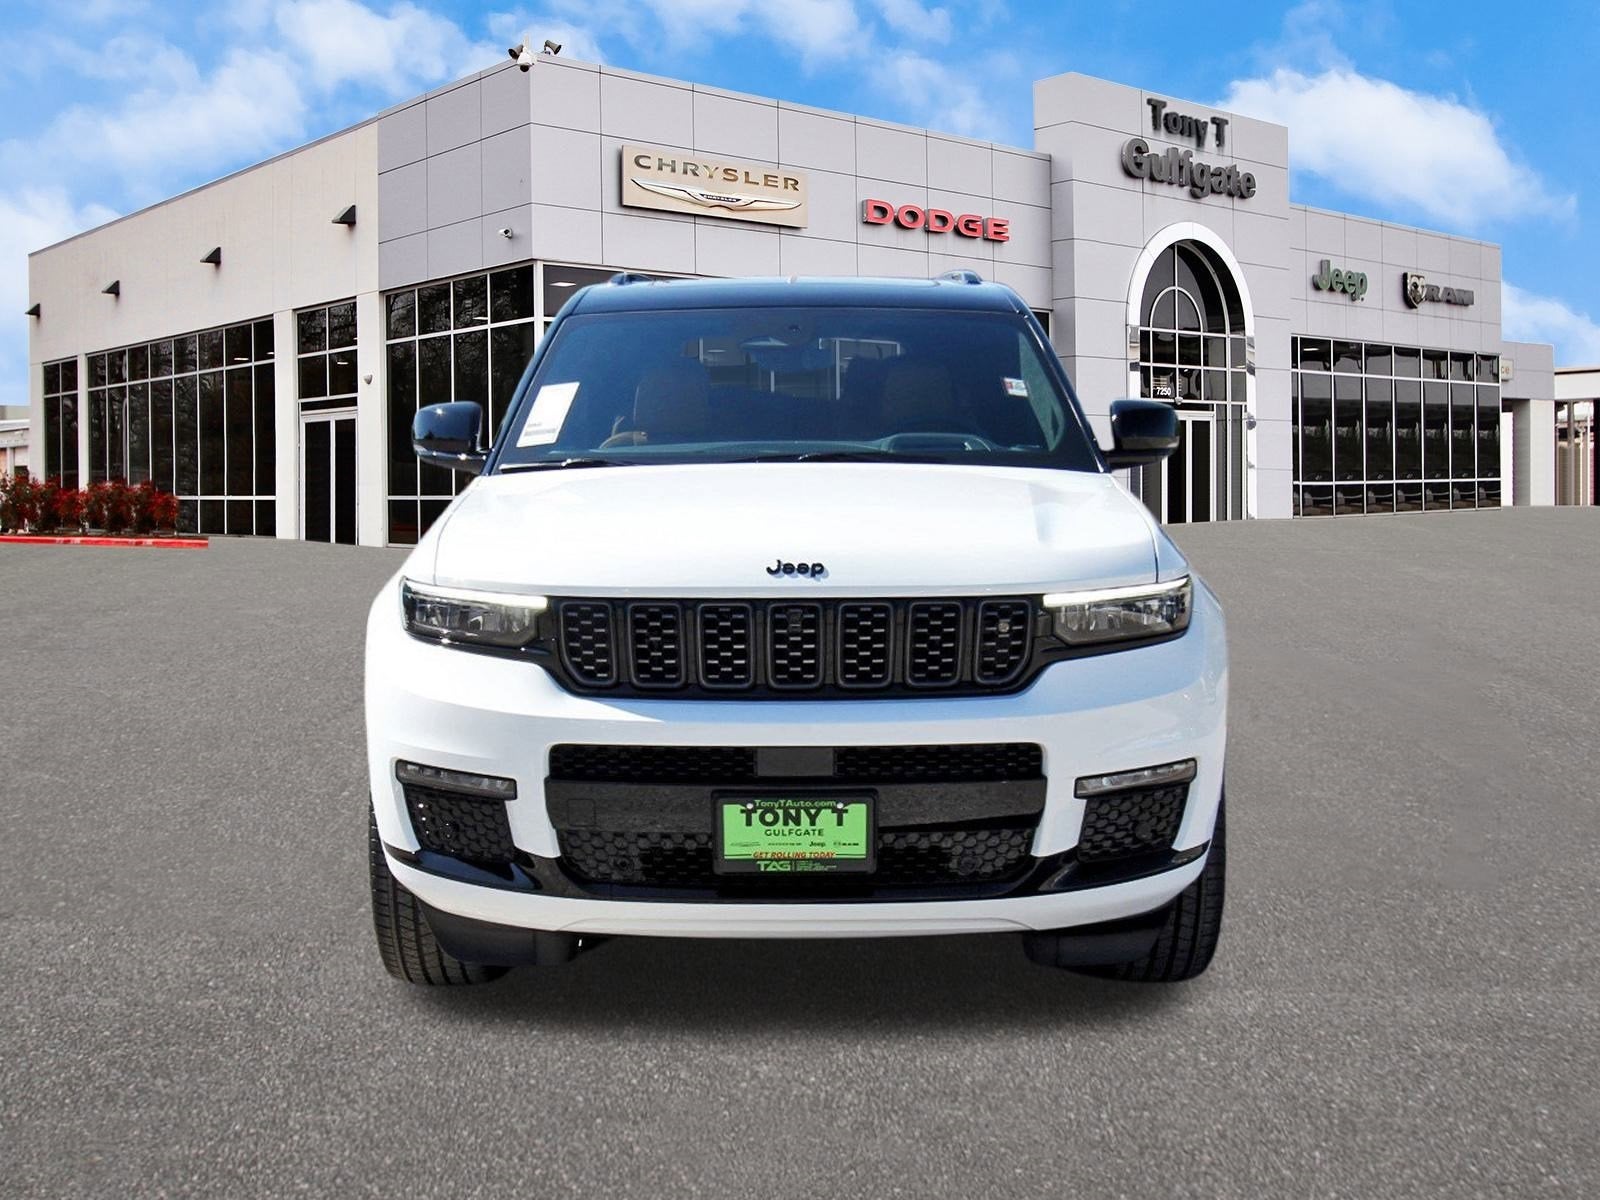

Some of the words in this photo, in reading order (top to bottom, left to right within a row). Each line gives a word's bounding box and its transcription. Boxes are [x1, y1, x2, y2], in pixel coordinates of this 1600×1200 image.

[1146, 98, 1208, 147] Tony
[1210, 116, 1229, 147] T
[633, 153, 800, 192] CHRYSLER
[1121, 138, 1257, 199] Gulfgate
[862, 199, 1010, 242] DODGE
[1312, 259, 1368, 301] Jeep
[1424, 284, 1475, 306] RAM
[766, 559, 825, 578] Jeep
[754, 799, 837, 809] TonyTAuto.com
[740, 808, 822, 827] TONY
[831, 808, 848, 827] T
[764, 828, 825, 837] GULFGATE
[753, 851, 769, 859] GET
[771, 851, 807, 859] ROLLING
[809, 851, 837, 859] TODAY
[756, 860, 791, 871] TAG
